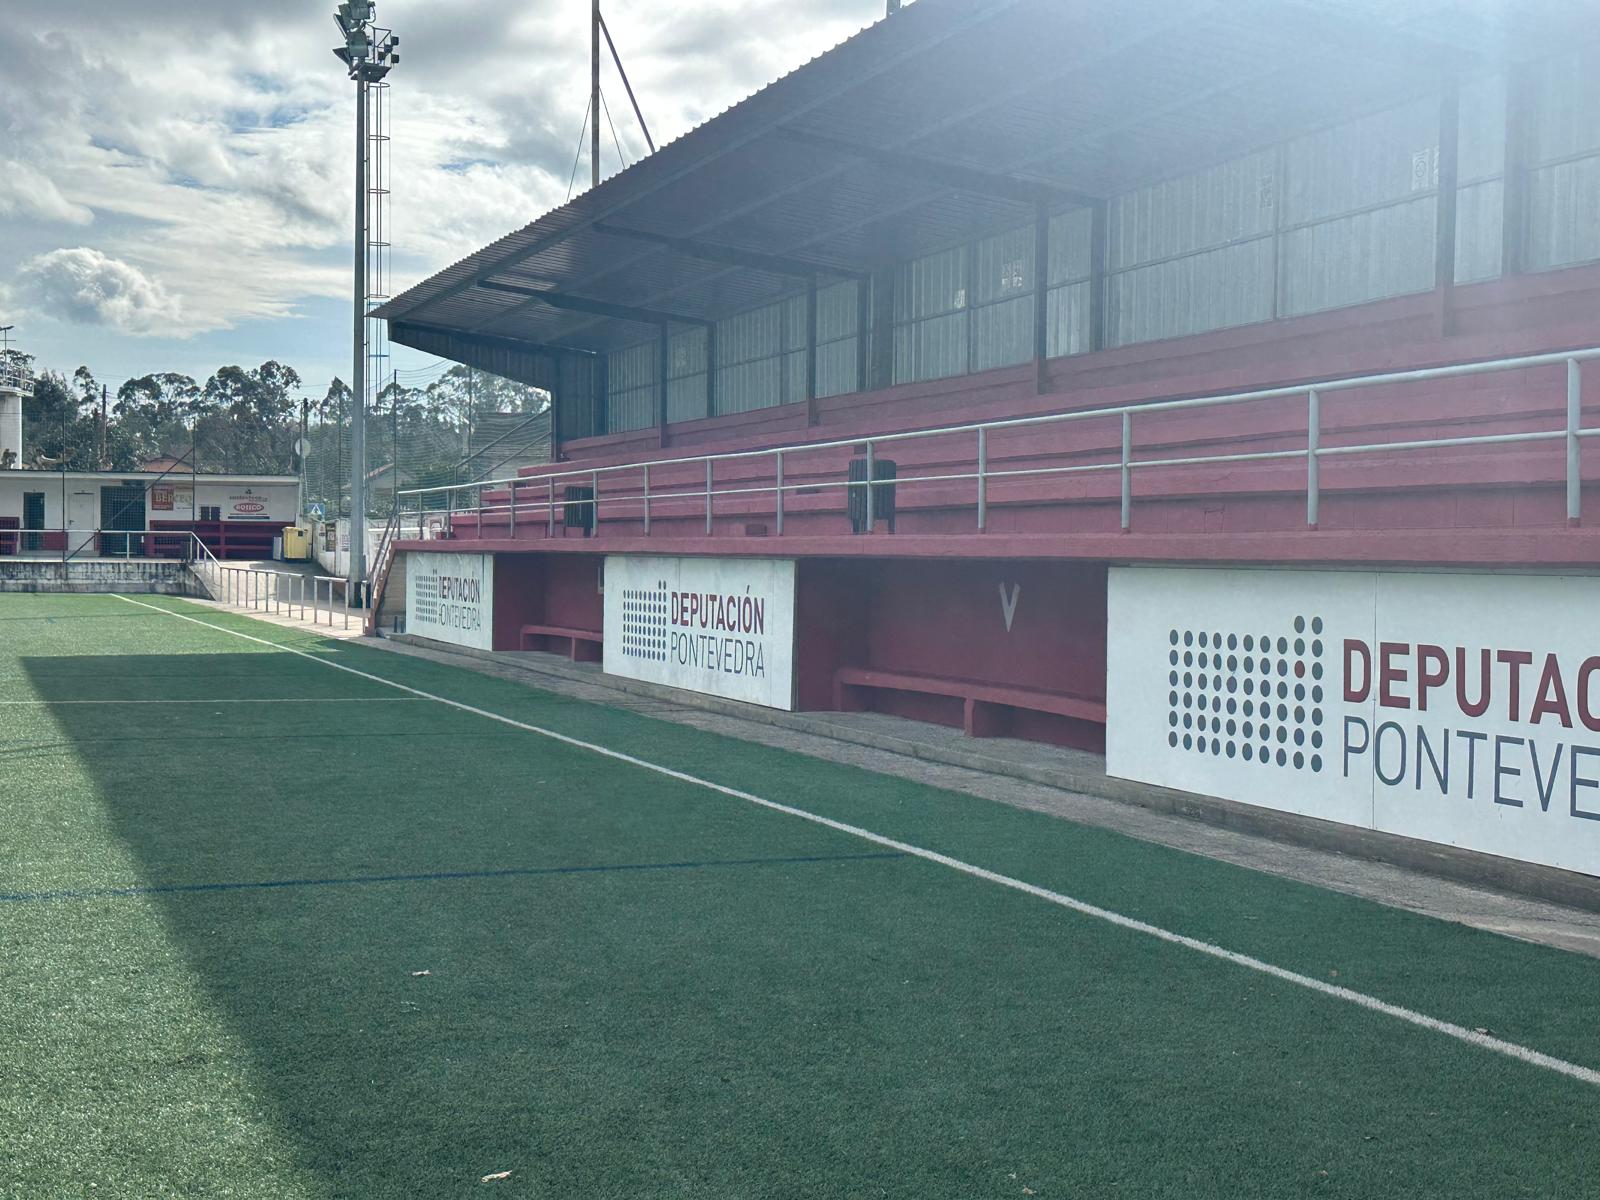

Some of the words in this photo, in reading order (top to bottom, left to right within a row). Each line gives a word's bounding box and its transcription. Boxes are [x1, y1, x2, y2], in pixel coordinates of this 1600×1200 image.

[439, 571, 481, 604] DEPUTACIÓN
[671, 584, 764, 635] DEPUTACIÓN
[438, 603, 481, 632] PONTEVEDRA
[670, 631, 765, 678] PONTEVEDRA
[1343, 638, 1600, 732] DEPUTAC
[1343, 715, 1600, 821] PONTEVE
